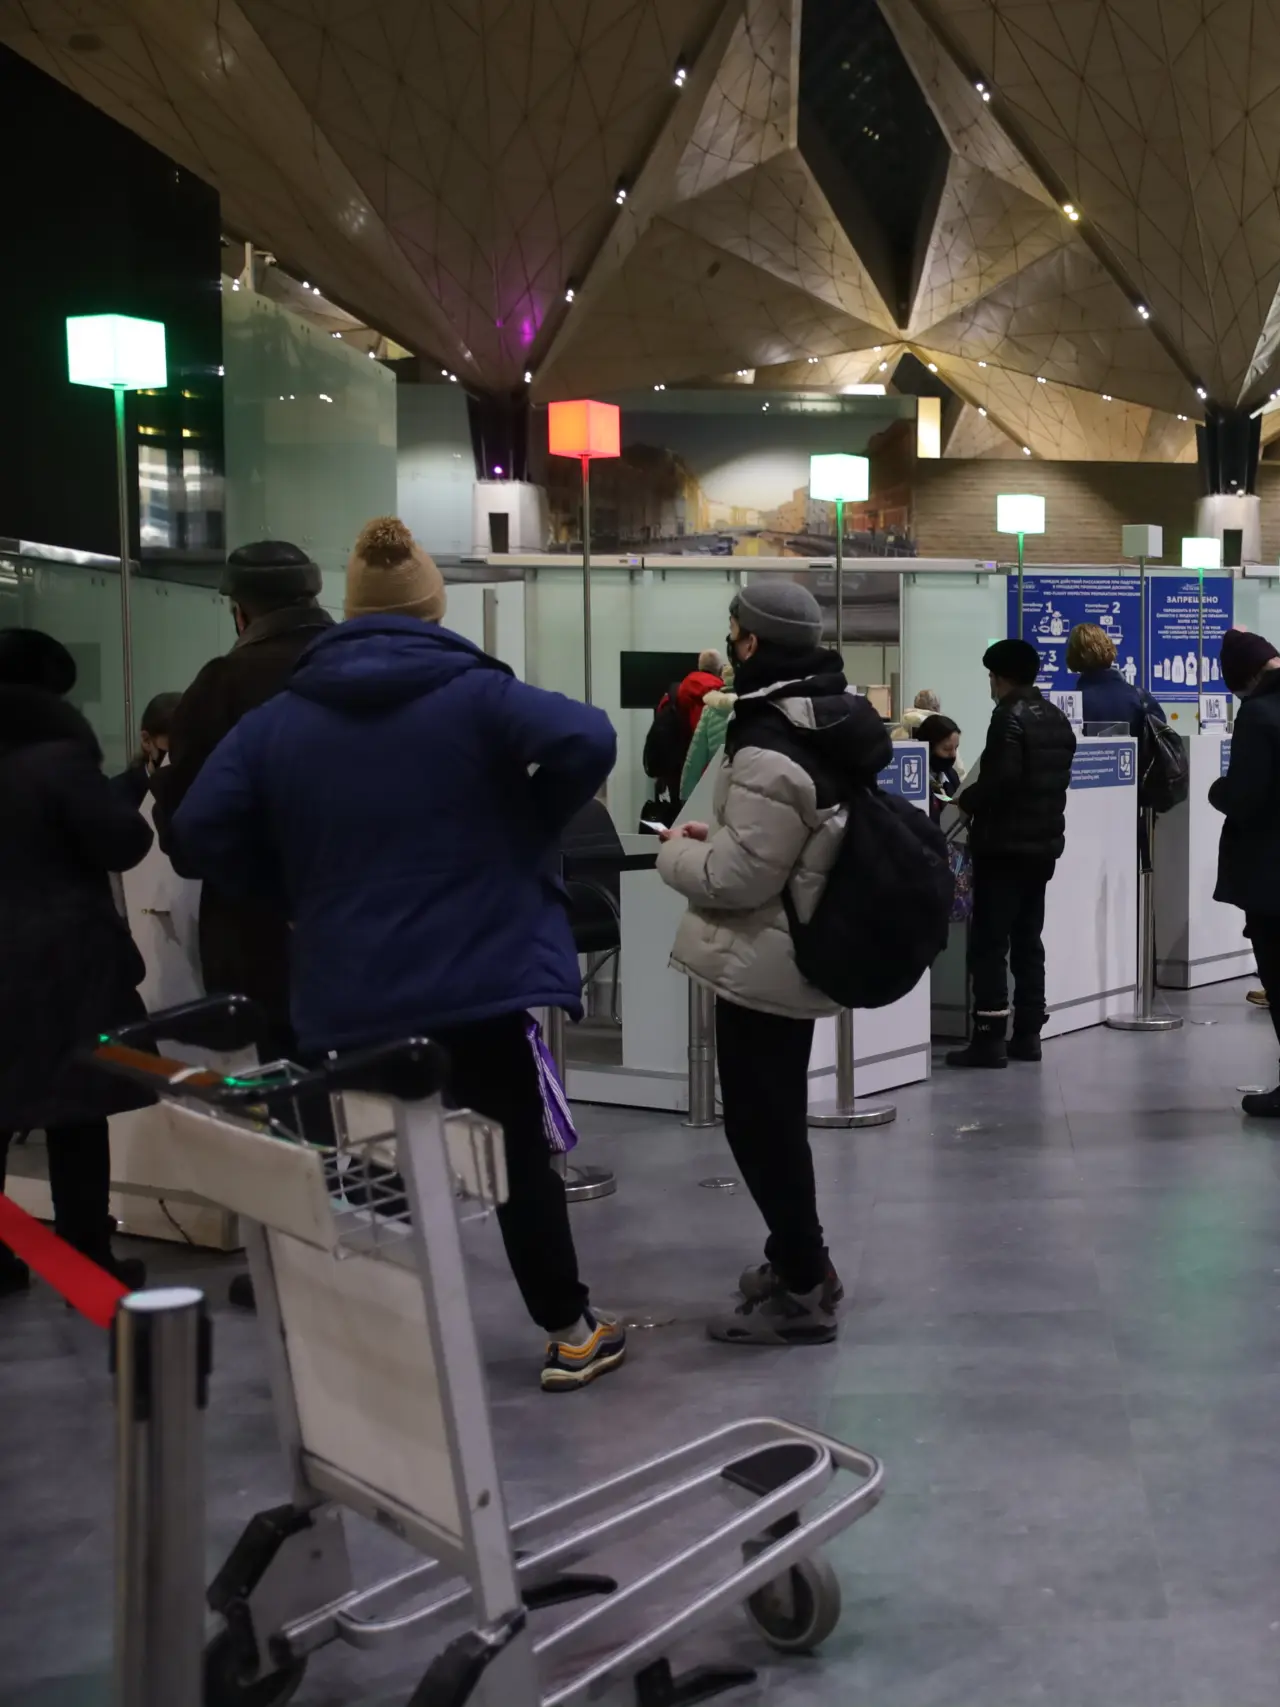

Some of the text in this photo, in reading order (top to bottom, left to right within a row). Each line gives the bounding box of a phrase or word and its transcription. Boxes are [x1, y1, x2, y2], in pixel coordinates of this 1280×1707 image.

[1045, 601, 1053, 613] 1
[1112, 601, 1120, 613] 2
[1048, 650, 1057, 663] 3
